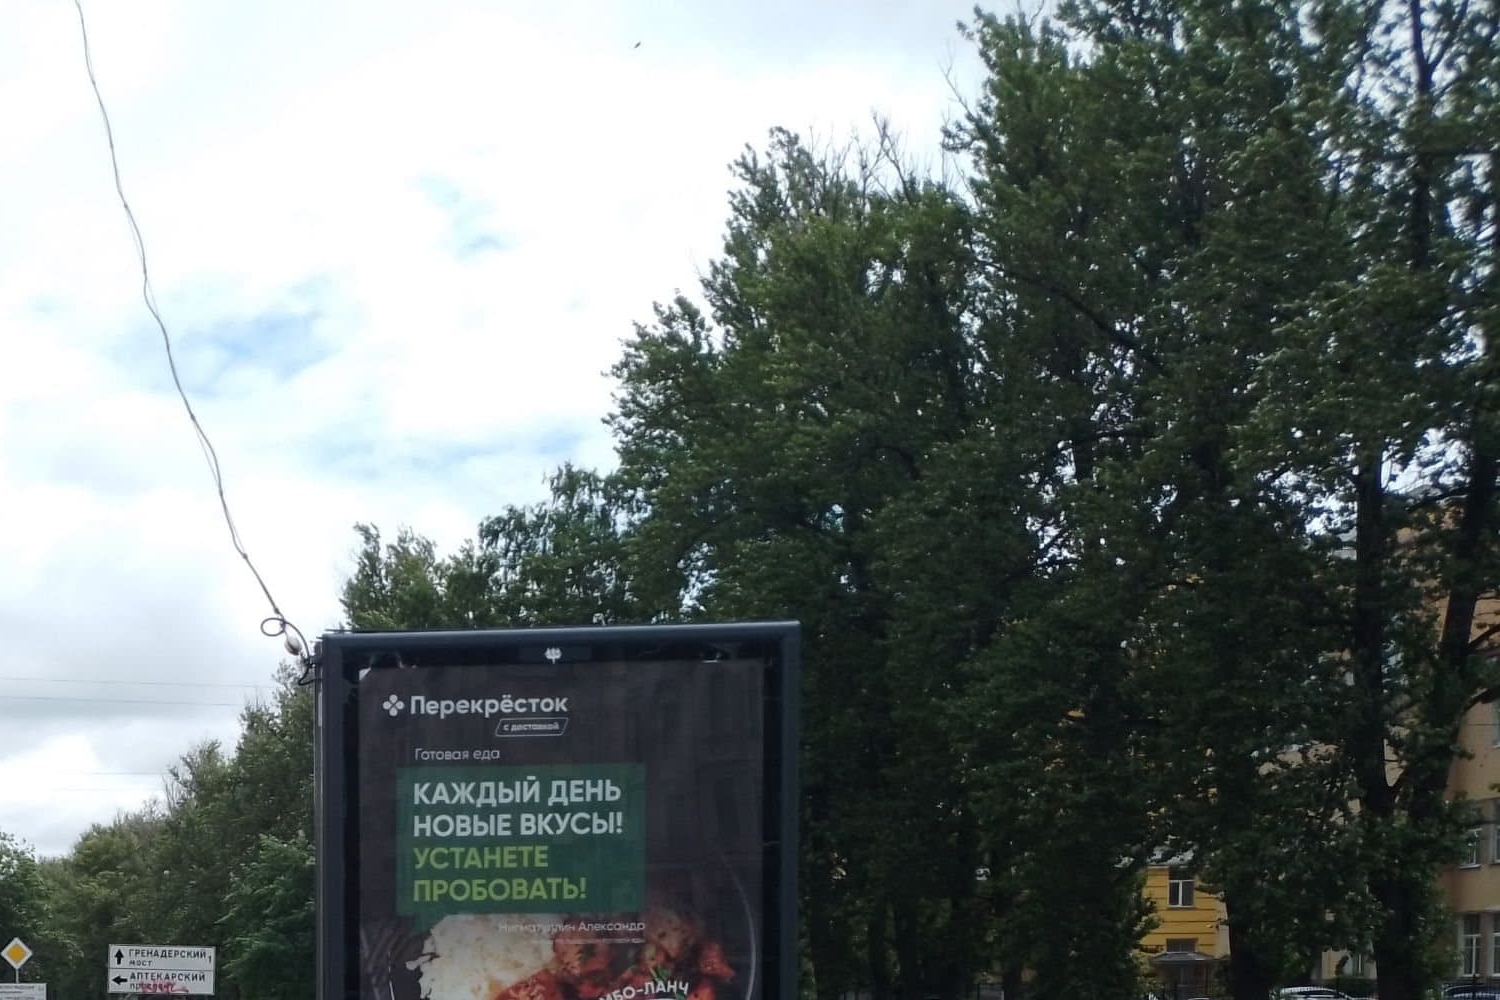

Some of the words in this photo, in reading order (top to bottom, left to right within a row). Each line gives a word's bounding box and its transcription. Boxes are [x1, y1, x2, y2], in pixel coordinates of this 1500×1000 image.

[410, 694, 569, 719] Перекрёсток
[415, 748, 469, 760] Готовая
[473, 750, 500, 760] еда
[414, 776, 540, 807] КАЖДЫЙ
[548, 779, 622, 806] ДЕНЬ
[414, 814, 512, 837] НОВЫЕ
[520, 811, 623, 836] ВКУСЫ!
[413, 846, 549, 869] УСТАНЕТЕ
[413, 877, 587, 902] ПРОБОВАТЬ!
[579, 921, 645, 932] Александр
[129, 948, 206, 958] ГРЕНАДЕРСКИЙ
[130, 971, 206, 982] АПТЕКАРСКИЙ
